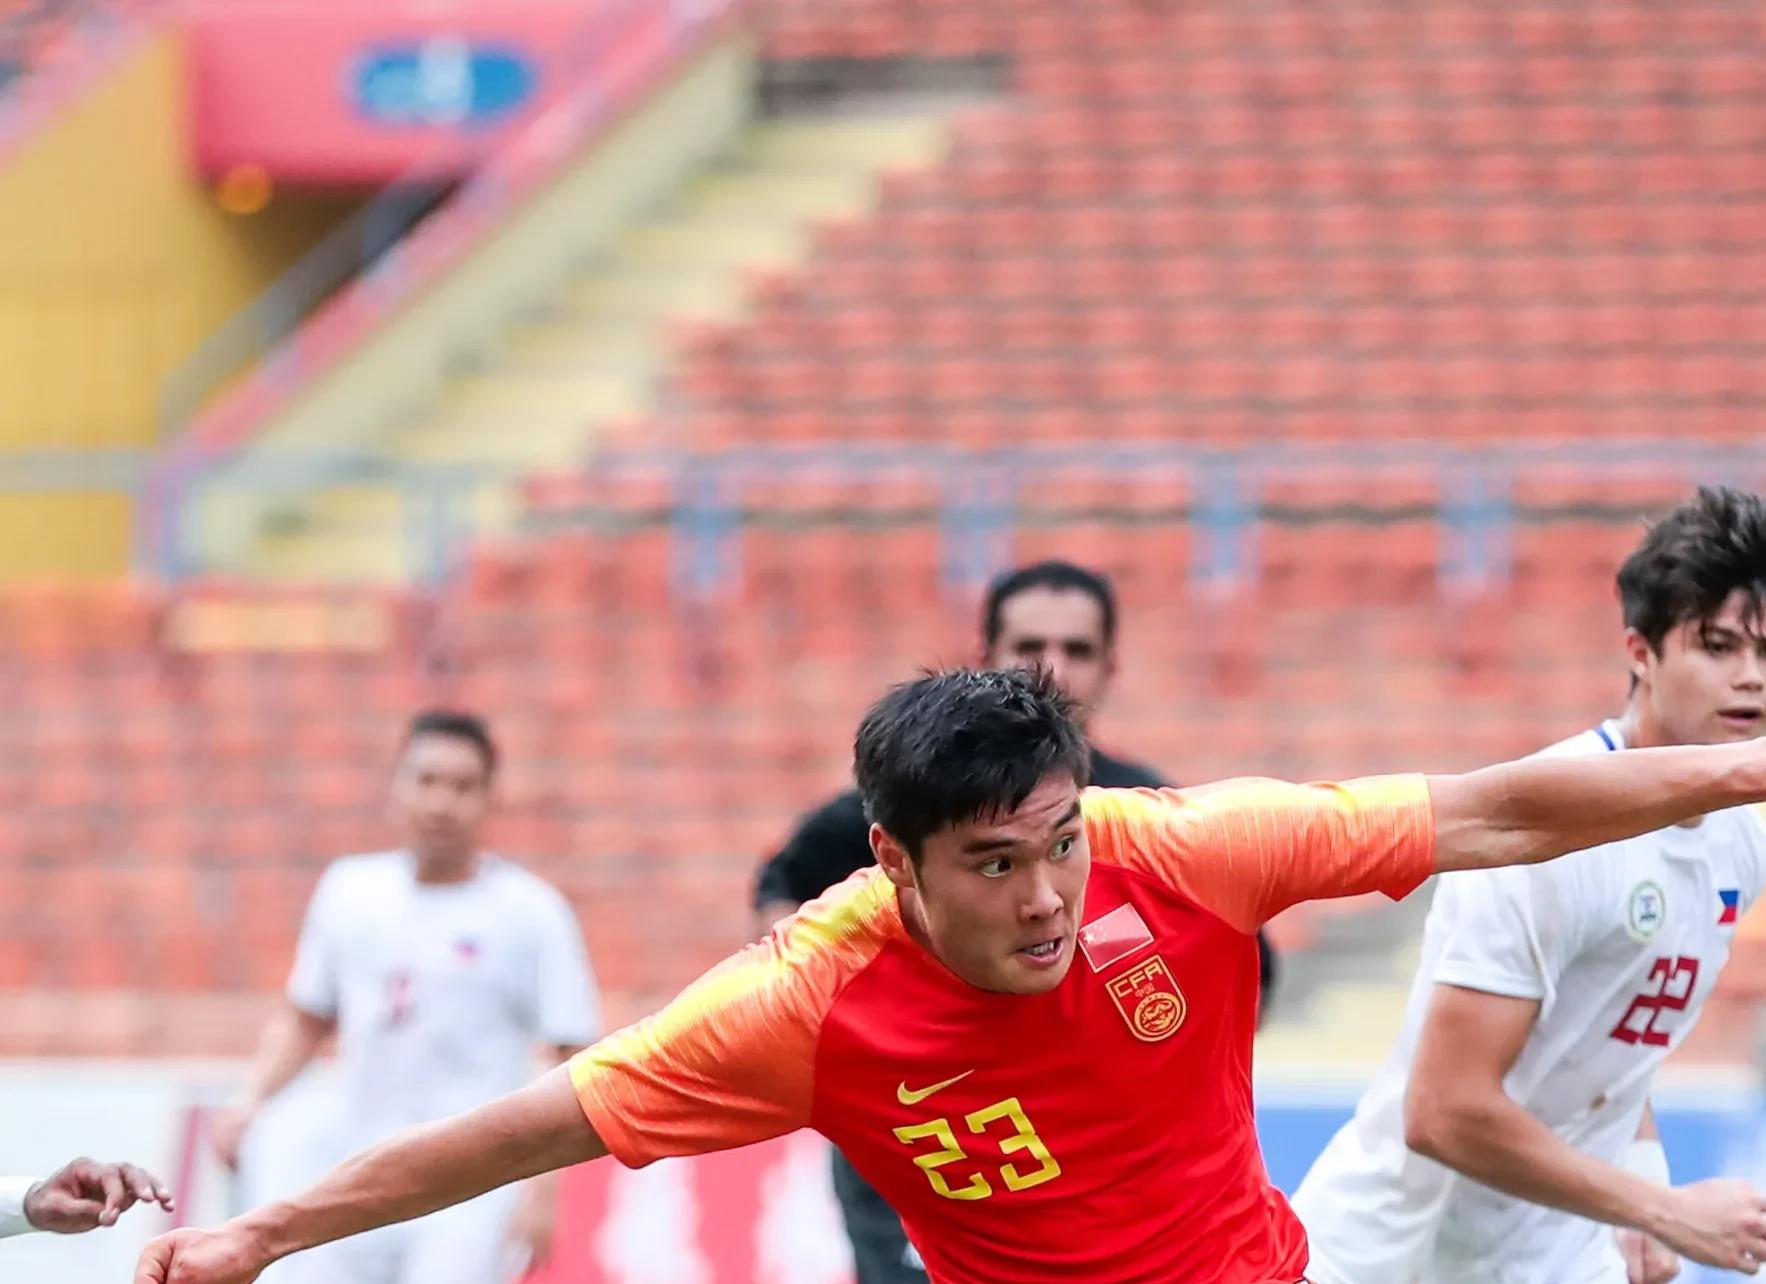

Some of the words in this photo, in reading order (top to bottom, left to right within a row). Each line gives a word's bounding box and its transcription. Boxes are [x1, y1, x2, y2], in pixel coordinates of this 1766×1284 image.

[1112, 961, 1164, 998] CFA
[1609, 955, 1699, 1046] 22
[892, 1096, 1062, 1200] 23
